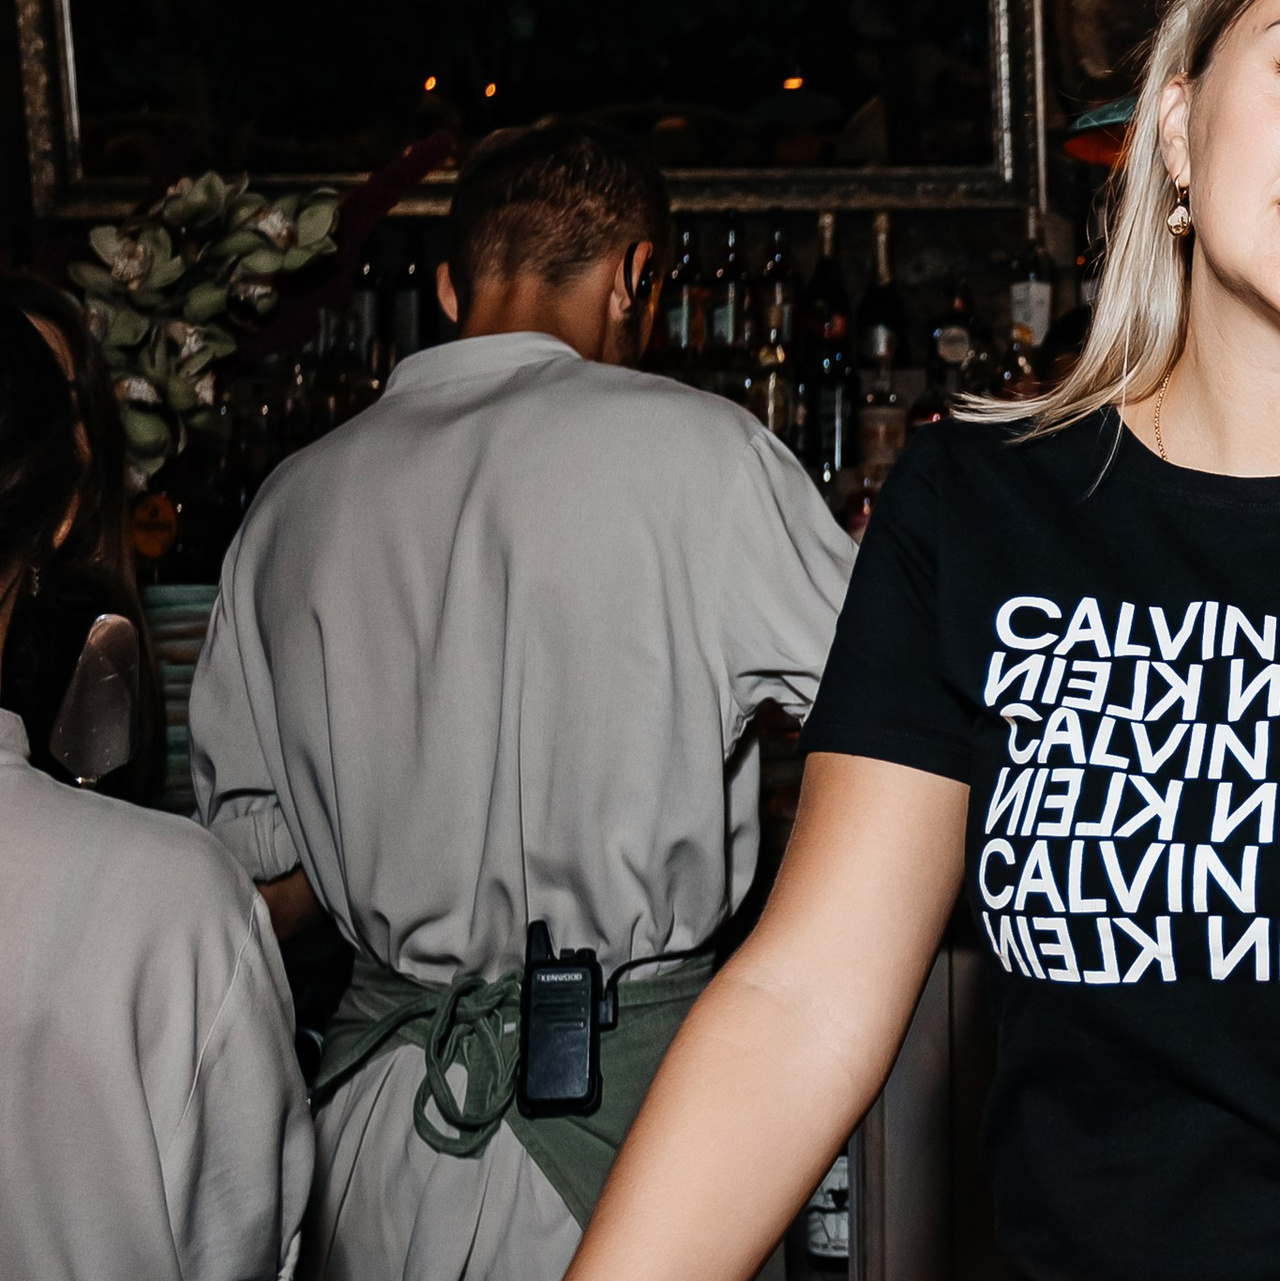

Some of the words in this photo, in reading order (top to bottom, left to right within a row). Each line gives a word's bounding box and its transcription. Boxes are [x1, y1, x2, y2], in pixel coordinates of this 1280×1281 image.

[996, 597, 1277, 661] CALVIN
[1000, 703, 1269, 780] CALVIN
[979, 838, 1259, 913] CALVIN
[541, 973, 582, 982] KENWOOD
